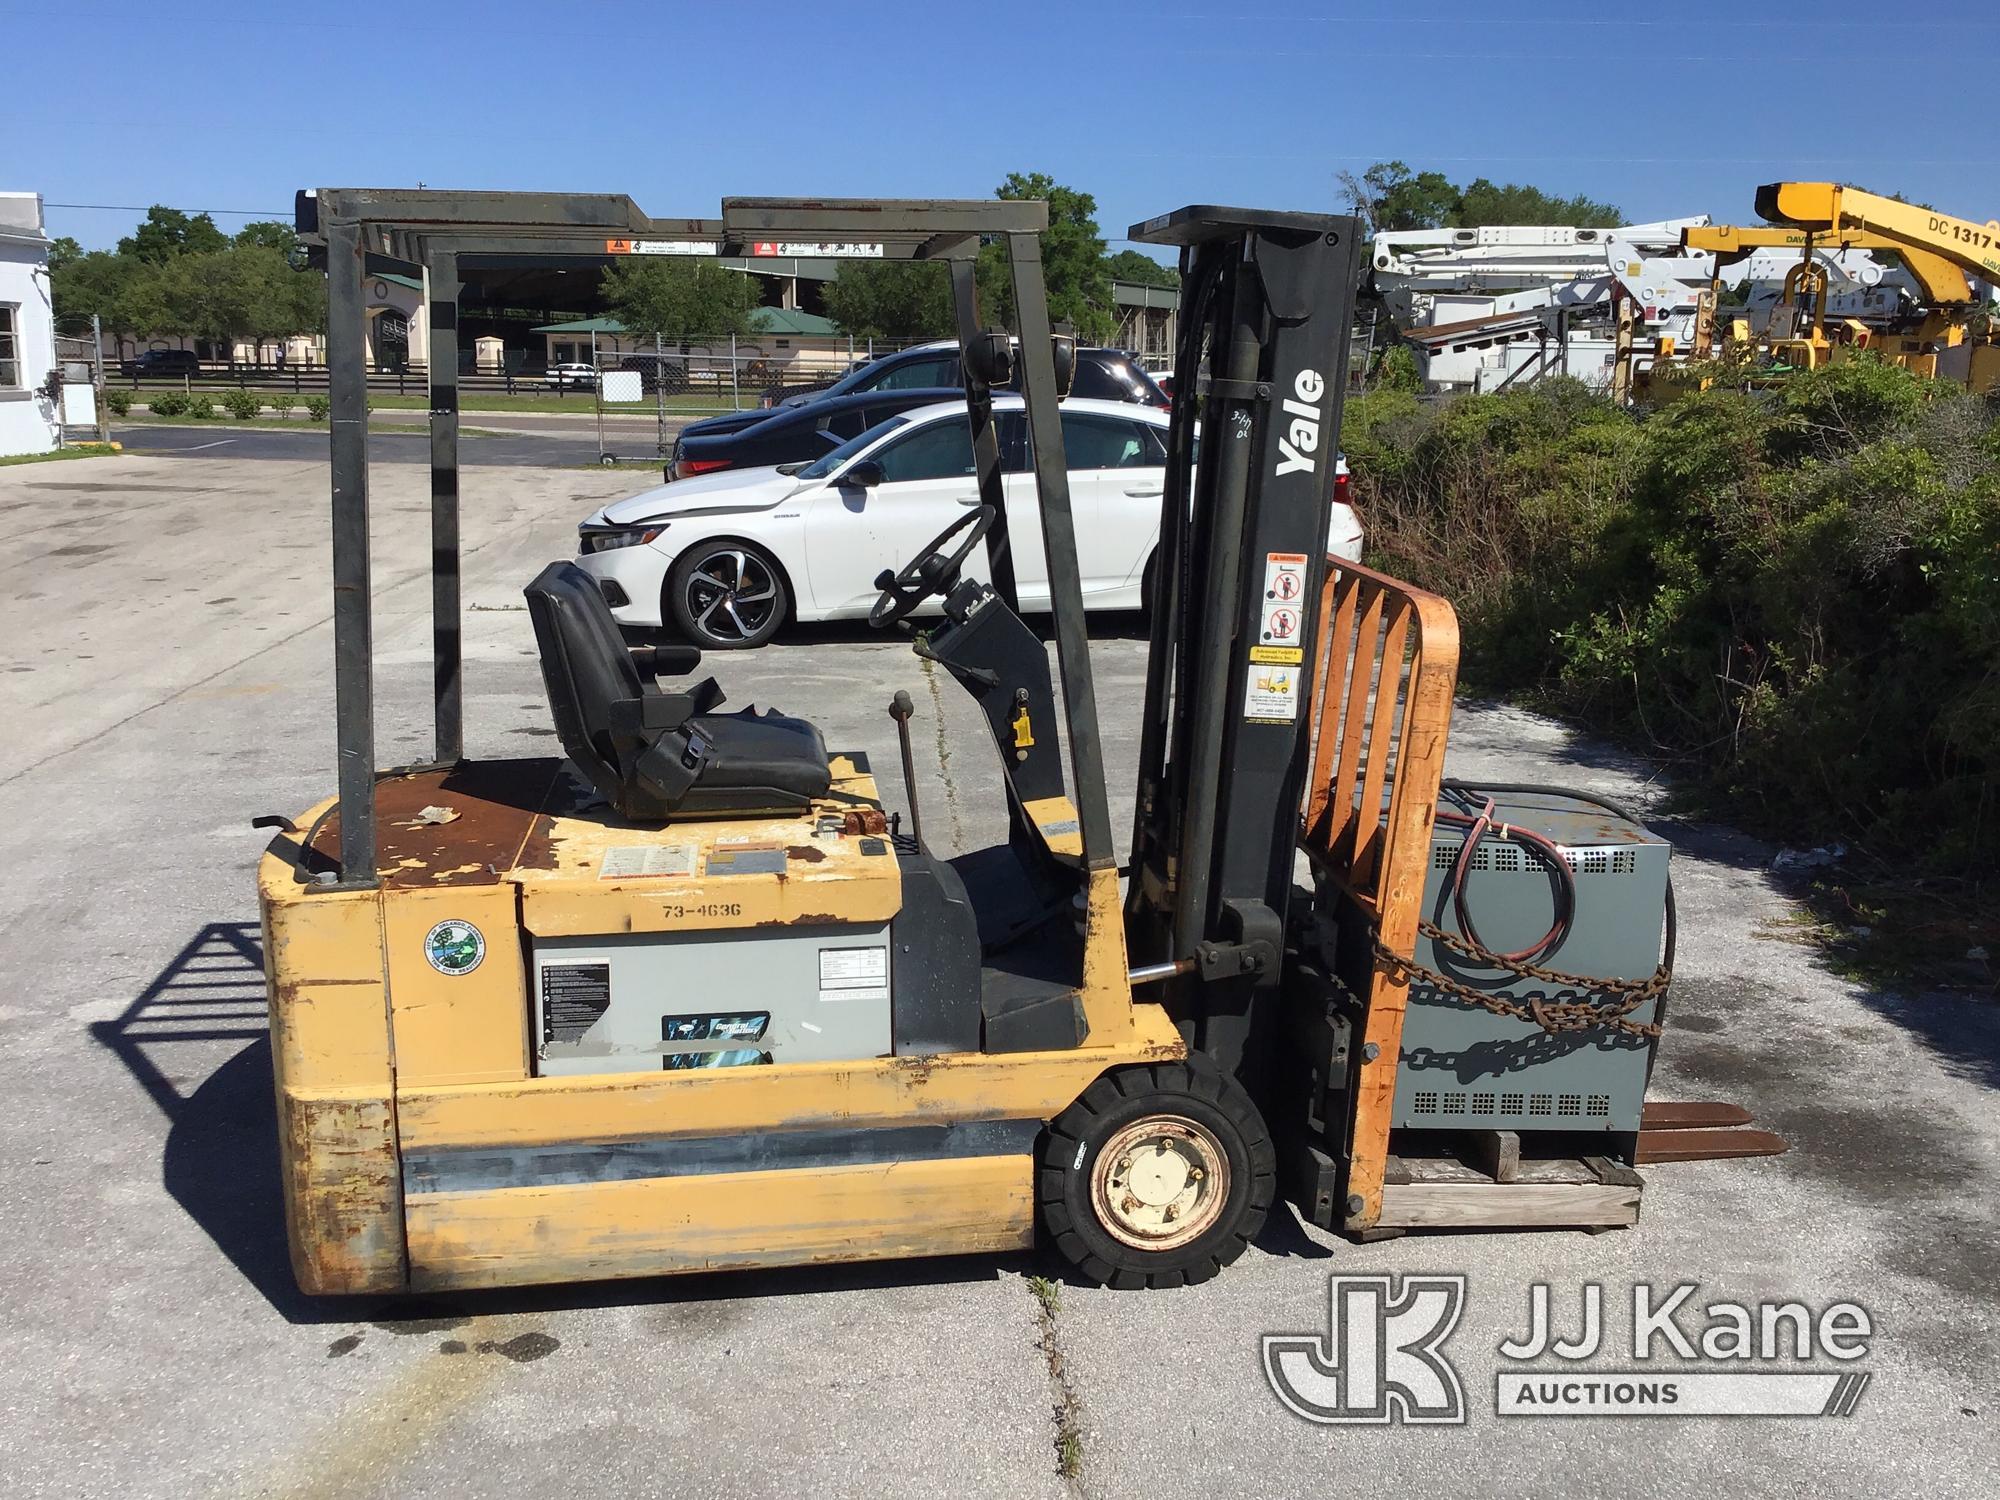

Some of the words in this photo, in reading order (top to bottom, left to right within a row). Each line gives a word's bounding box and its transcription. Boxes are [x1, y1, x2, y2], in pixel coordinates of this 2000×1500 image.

[1929, 216, 1949, 235] DC
[1953, 225, 1992, 249] 1317
[1275, 368, 1325, 477] Yale
[662, 903, 742, 919] 73-4636
[466, 925, 483, 945] FLORIDA
